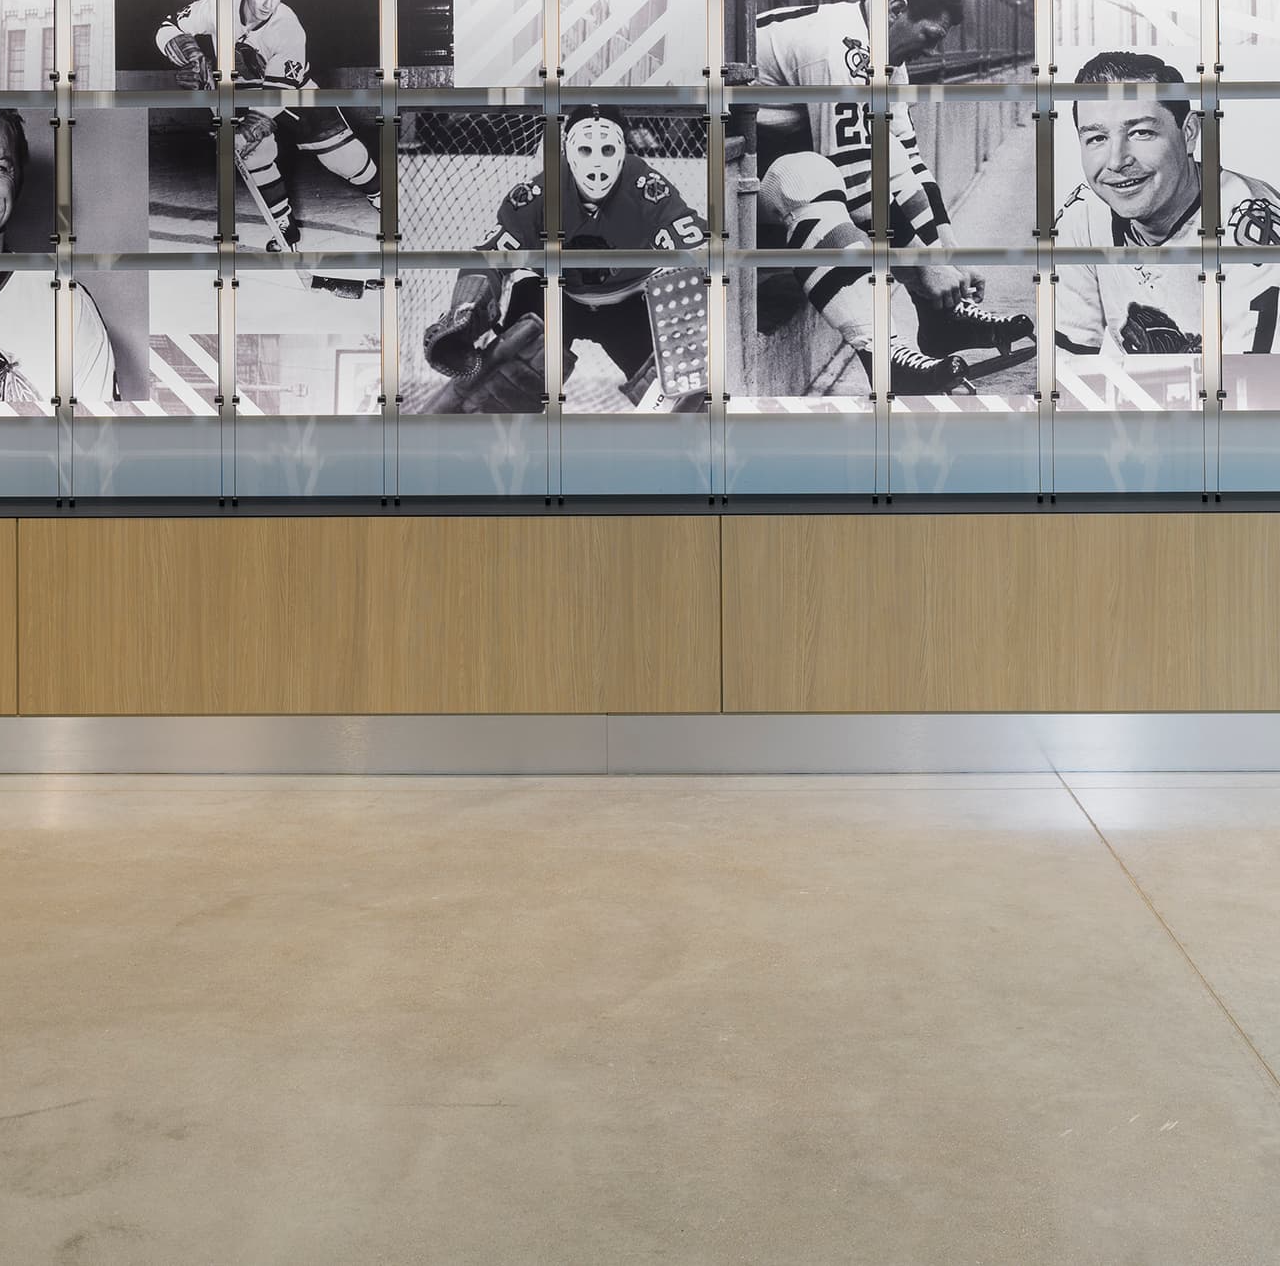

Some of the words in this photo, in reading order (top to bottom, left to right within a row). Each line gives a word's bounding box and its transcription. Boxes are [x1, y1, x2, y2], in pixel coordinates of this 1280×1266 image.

[654, 215, 704, 251] 35
[1243, 285, 1280, 354] 1
[677, 371, 701, 393] 35
